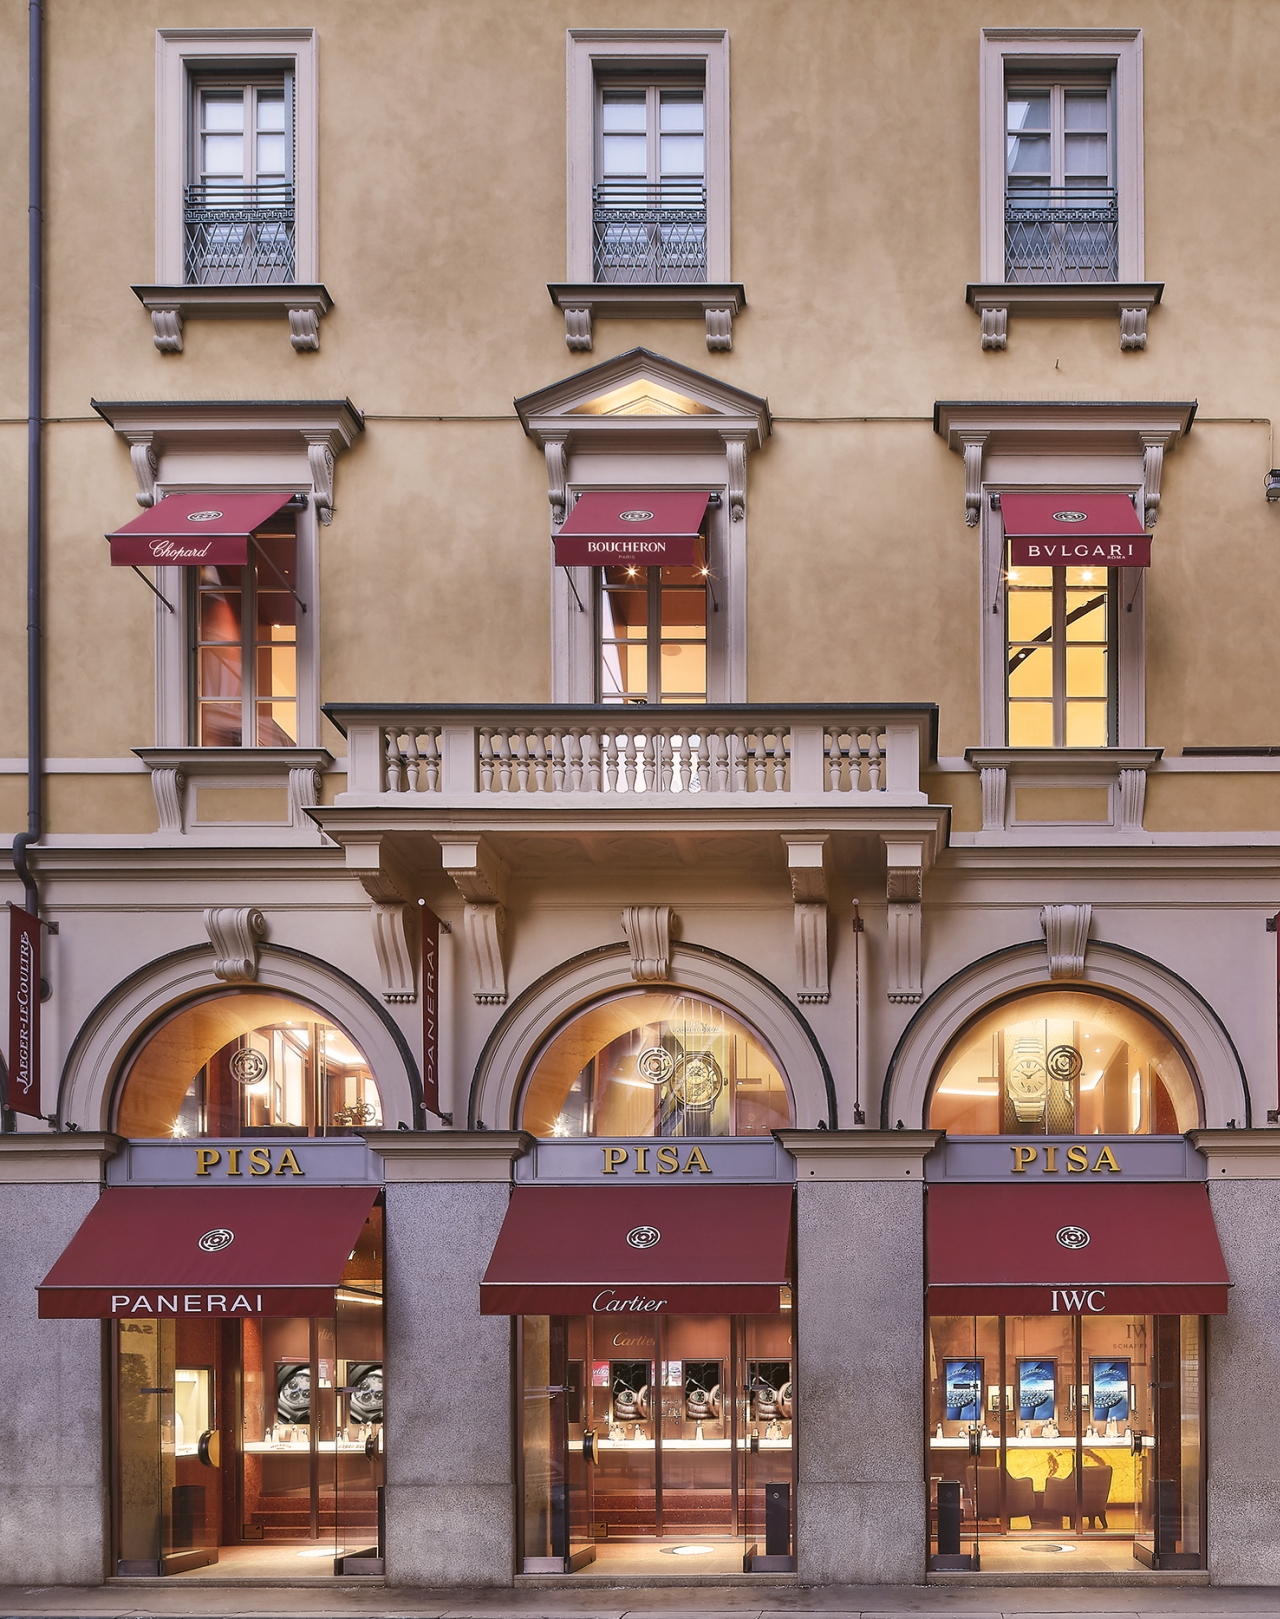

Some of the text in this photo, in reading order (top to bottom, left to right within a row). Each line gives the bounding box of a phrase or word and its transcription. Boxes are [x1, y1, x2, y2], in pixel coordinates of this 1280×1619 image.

[148, 539, 212, 561] Chopard
[588, 541, 666, 552] BOUCHERON
[1028, 544, 1133, 557] BVLGARI
[426, 937, 435, 1085] PANERAI
[195, 1147, 303, 1175] PISA
[602, 1146, 711, 1174] PISA
[1012, 1145, 1121, 1173] PISA
[111, 1294, 262, 1313] PANERAI
[592, 1289, 668, 1312] Cartier
[1051, 1290, 1106, 1312] IWC
